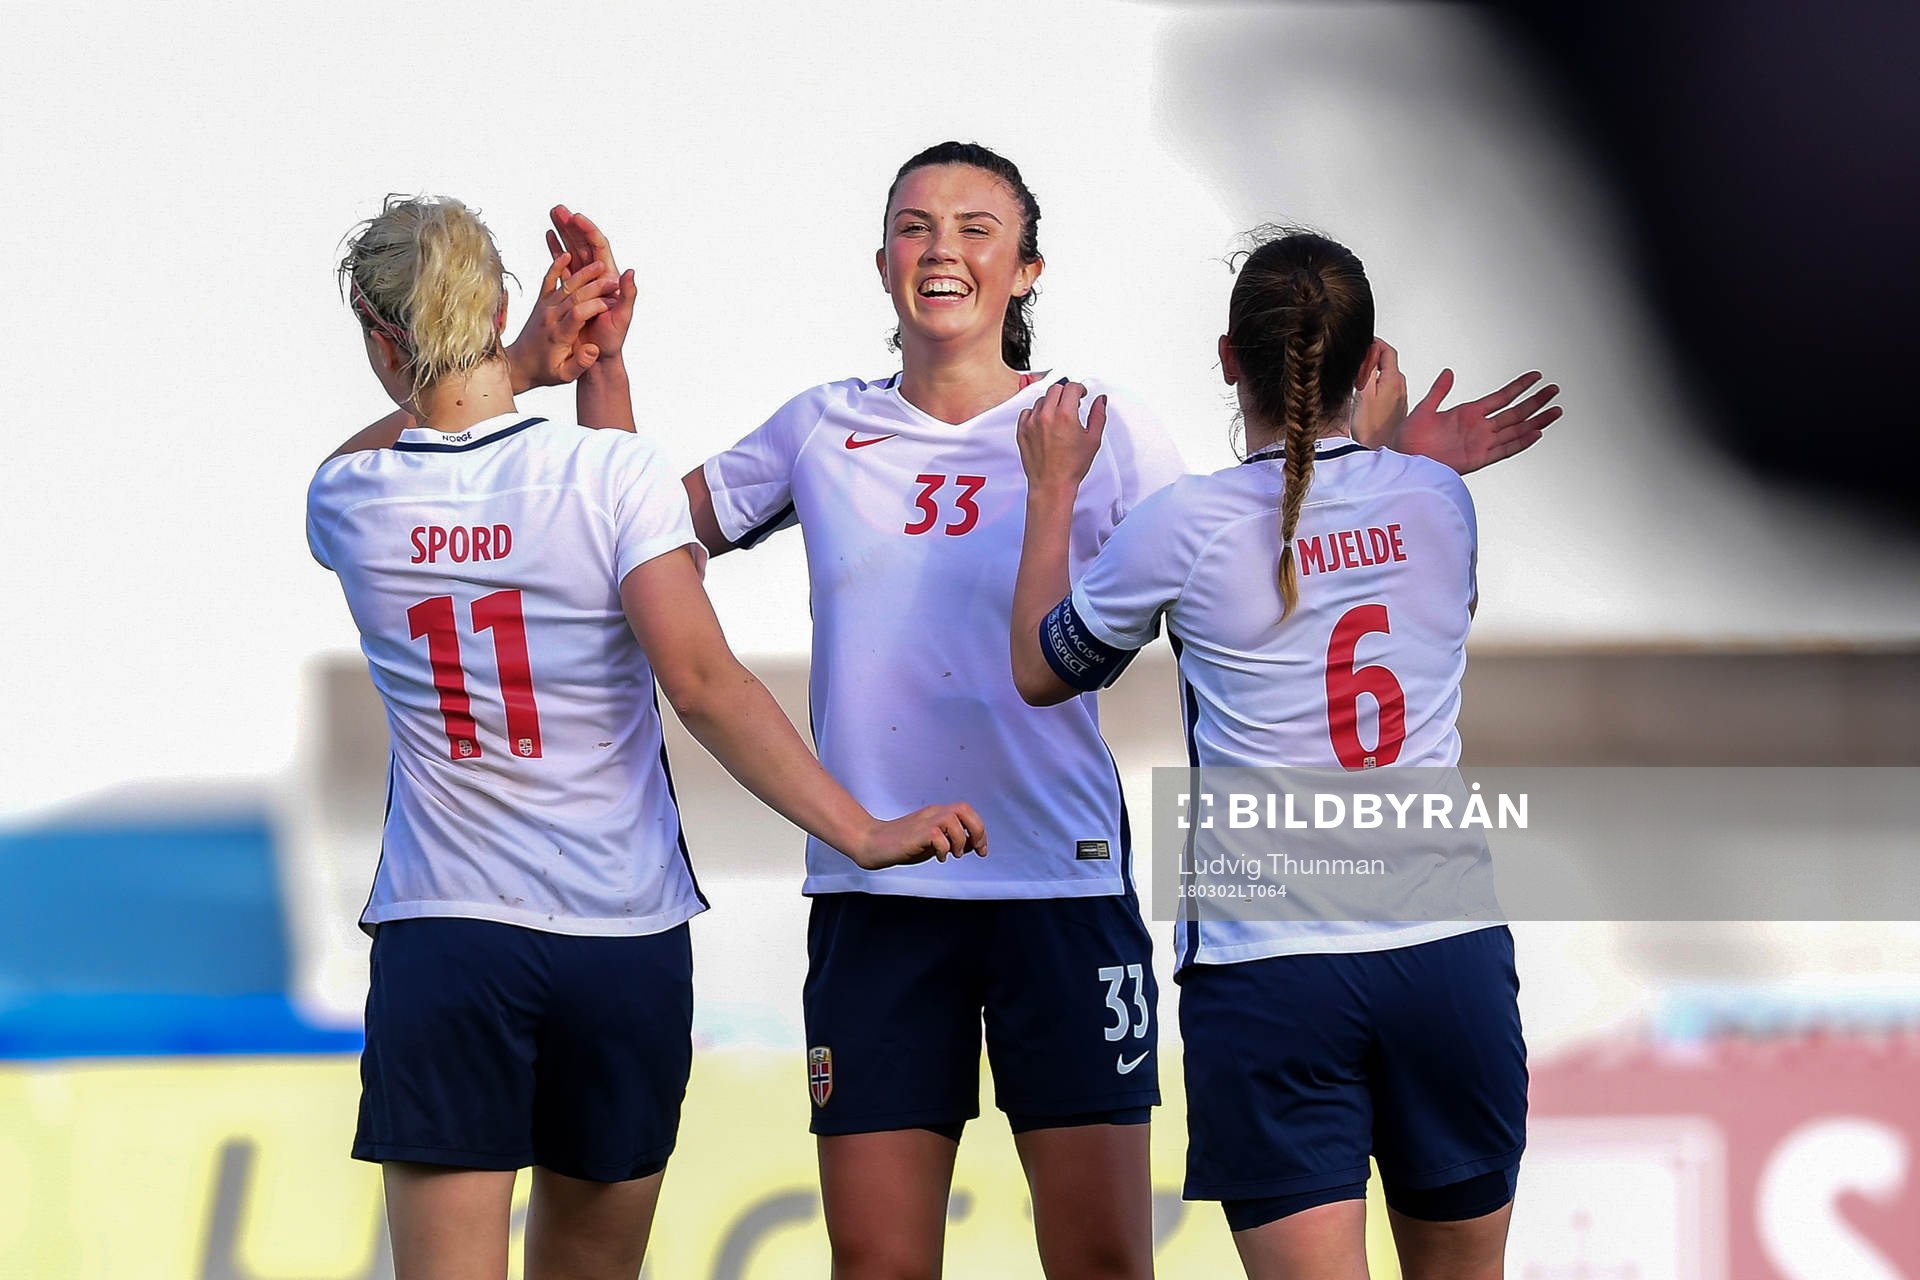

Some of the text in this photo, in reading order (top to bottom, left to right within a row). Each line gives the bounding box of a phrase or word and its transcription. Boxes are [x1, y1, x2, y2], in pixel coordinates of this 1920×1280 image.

[442, 431, 472, 442] NORGE
[903, 473, 987, 536] 33
[410, 523, 513, 564] SPORD
[1296, 523, 1408, 576] MJELDE
[1050, 623, 1088, 673] RESPECT
[1067, 625, 1106, 663] RACISM
[406, 589, 544, 760] 11
[1324, 602, 1406, 772] 6
[1098, 963, 1149, 1041] 33
